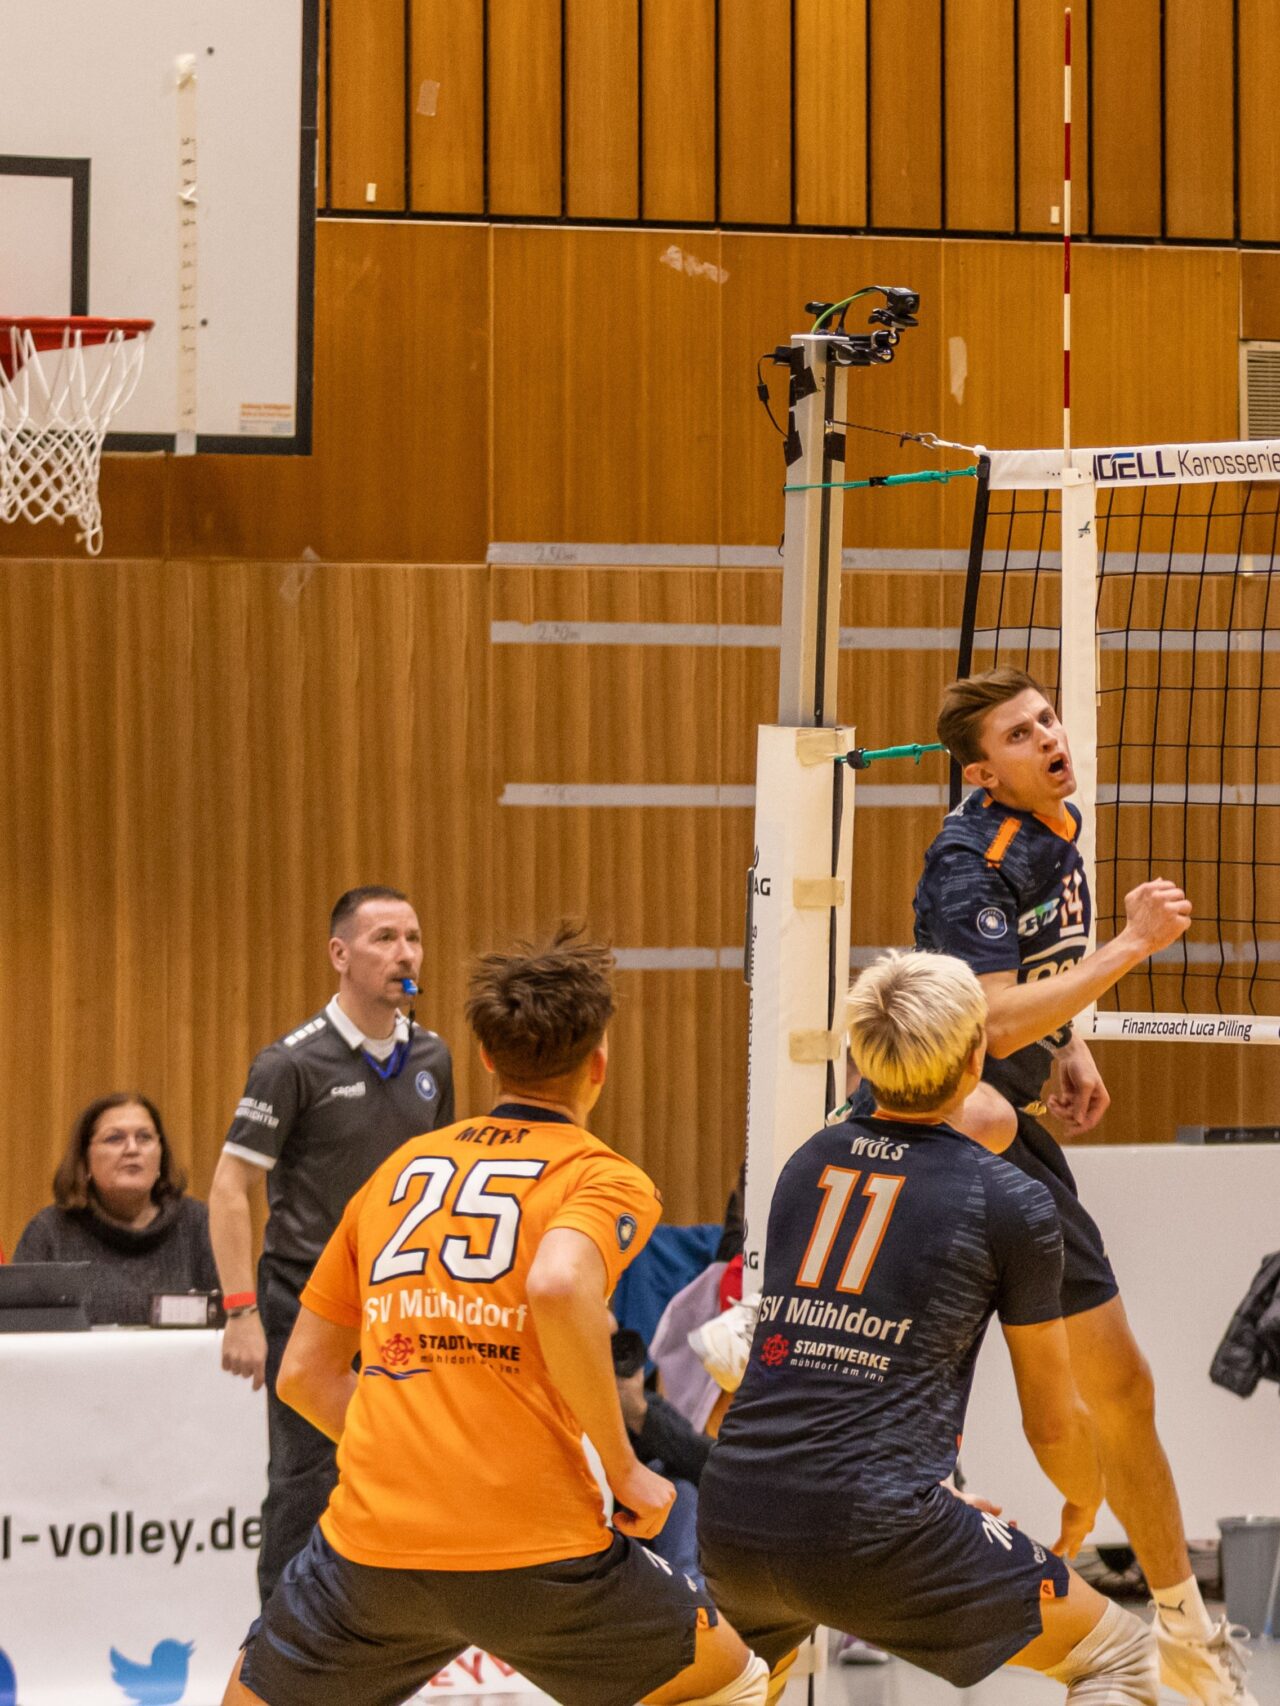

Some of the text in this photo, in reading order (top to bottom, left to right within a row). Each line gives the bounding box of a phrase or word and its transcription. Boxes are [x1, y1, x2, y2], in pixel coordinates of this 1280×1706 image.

[1121, 1017, 1188, 1037] Finanzcoach
[1189, 1018, 1215, 1036] Luca
[1217, 1019, 1253, 1041] Pilling
[369, 1155, 549, 1286] 25
[795, 1164, 906, 1295] 11
[400, 1287, 528, 1332] Mühldorf
[785, 1297, 913, 1345] Mühldorf
[790, 1357, 885, 1383] mühldorf am inn
[793, 1339, 892, 1371] STADTWERKE
